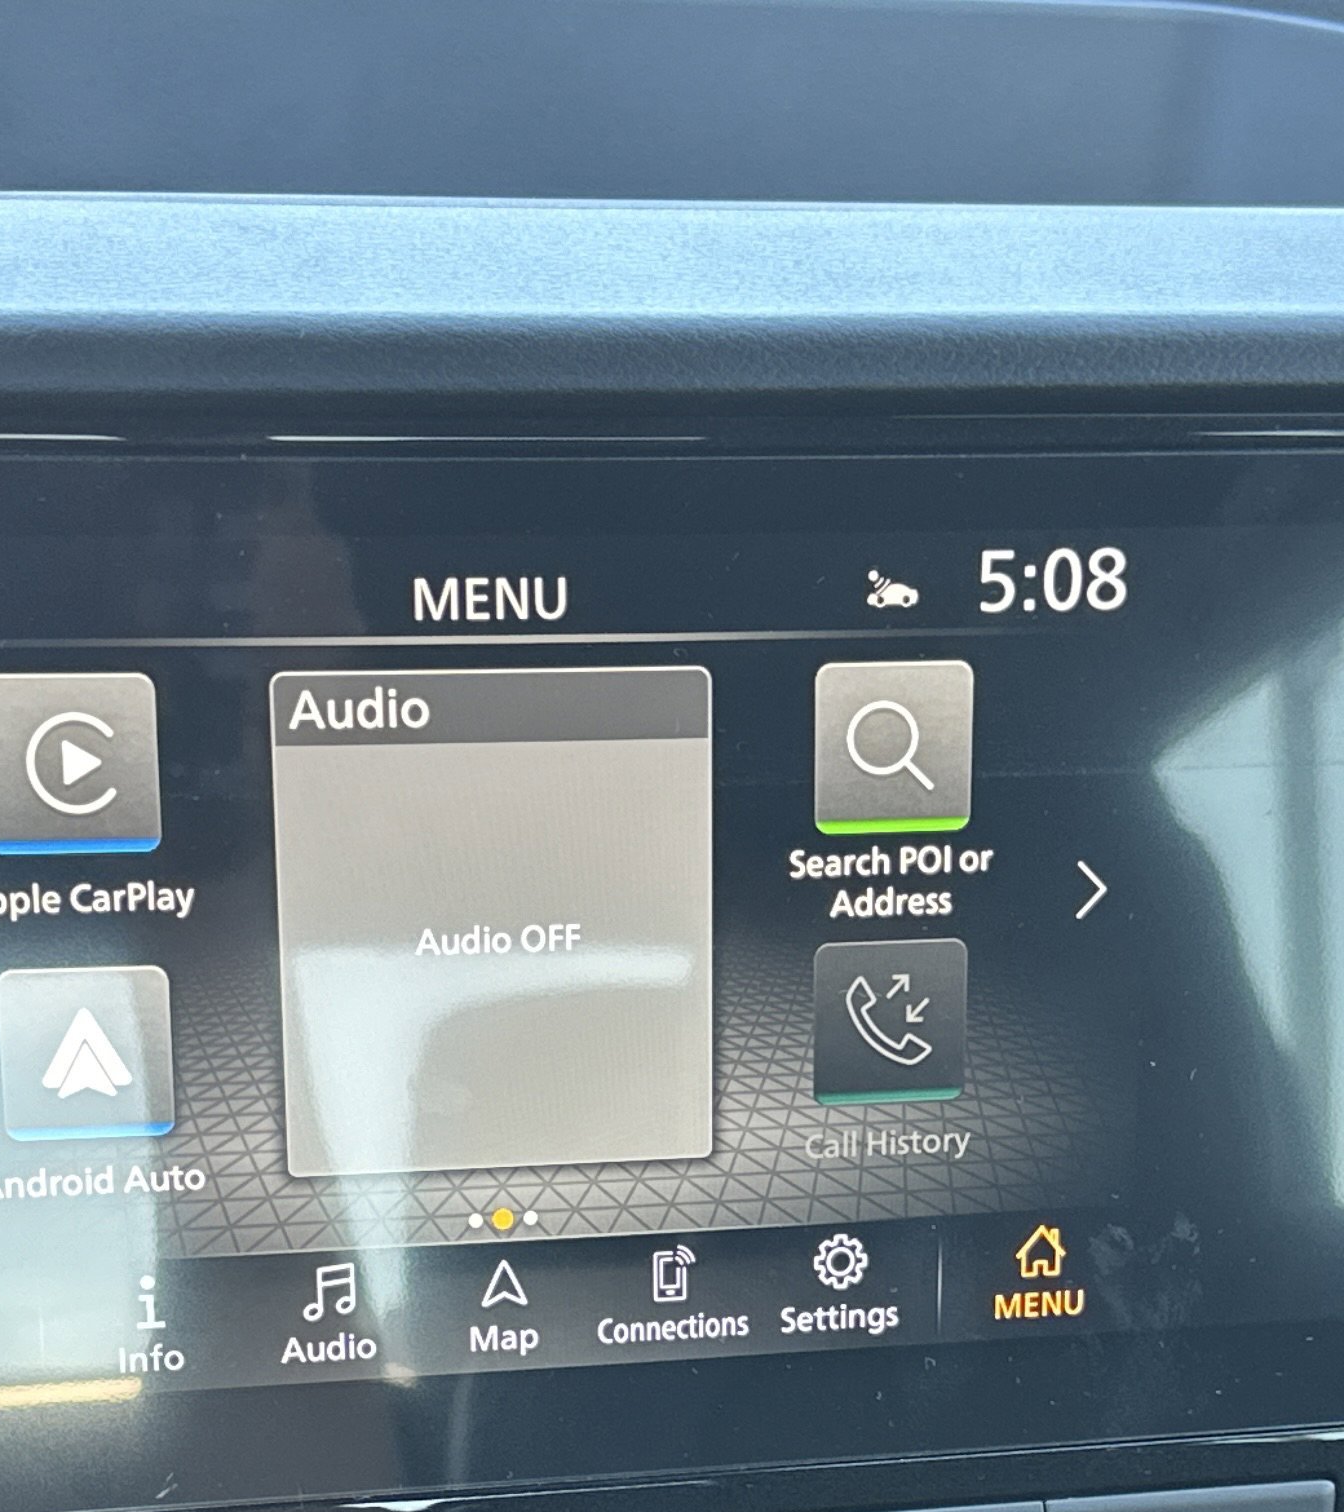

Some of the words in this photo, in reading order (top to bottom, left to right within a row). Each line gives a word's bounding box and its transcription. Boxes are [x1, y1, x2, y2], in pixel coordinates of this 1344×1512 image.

[979, 547, 1127, 613] 5:08
[413, 576, 567, 621] MENU
[288, 686, 430, 730] Audio
[789, 846, 891, 878] Search
[898, 846, 952, 874] POI
[958, 847, 994, 873] or
[69, 880, 196, 919] CarPlay
[830, 887, 953, 918] Address
[416, 926, 512, 956] Audio
[520, 924, 581, 953] OFF
[805, 1131, 857, 1160] Call
[866, 1128, 971, 1160] History
[123, 1164, 206, 1193] Auto
[780, 1304, 899, 1336] Settings
[994, 1289, 1085, 1320] MENU
[469, 1325, 539, 1355] Map
[597, 1311, 749, 1344] Connections
[118, 1343, 185, 1373] Info
[281, 1333, 377, 1364] Audio
